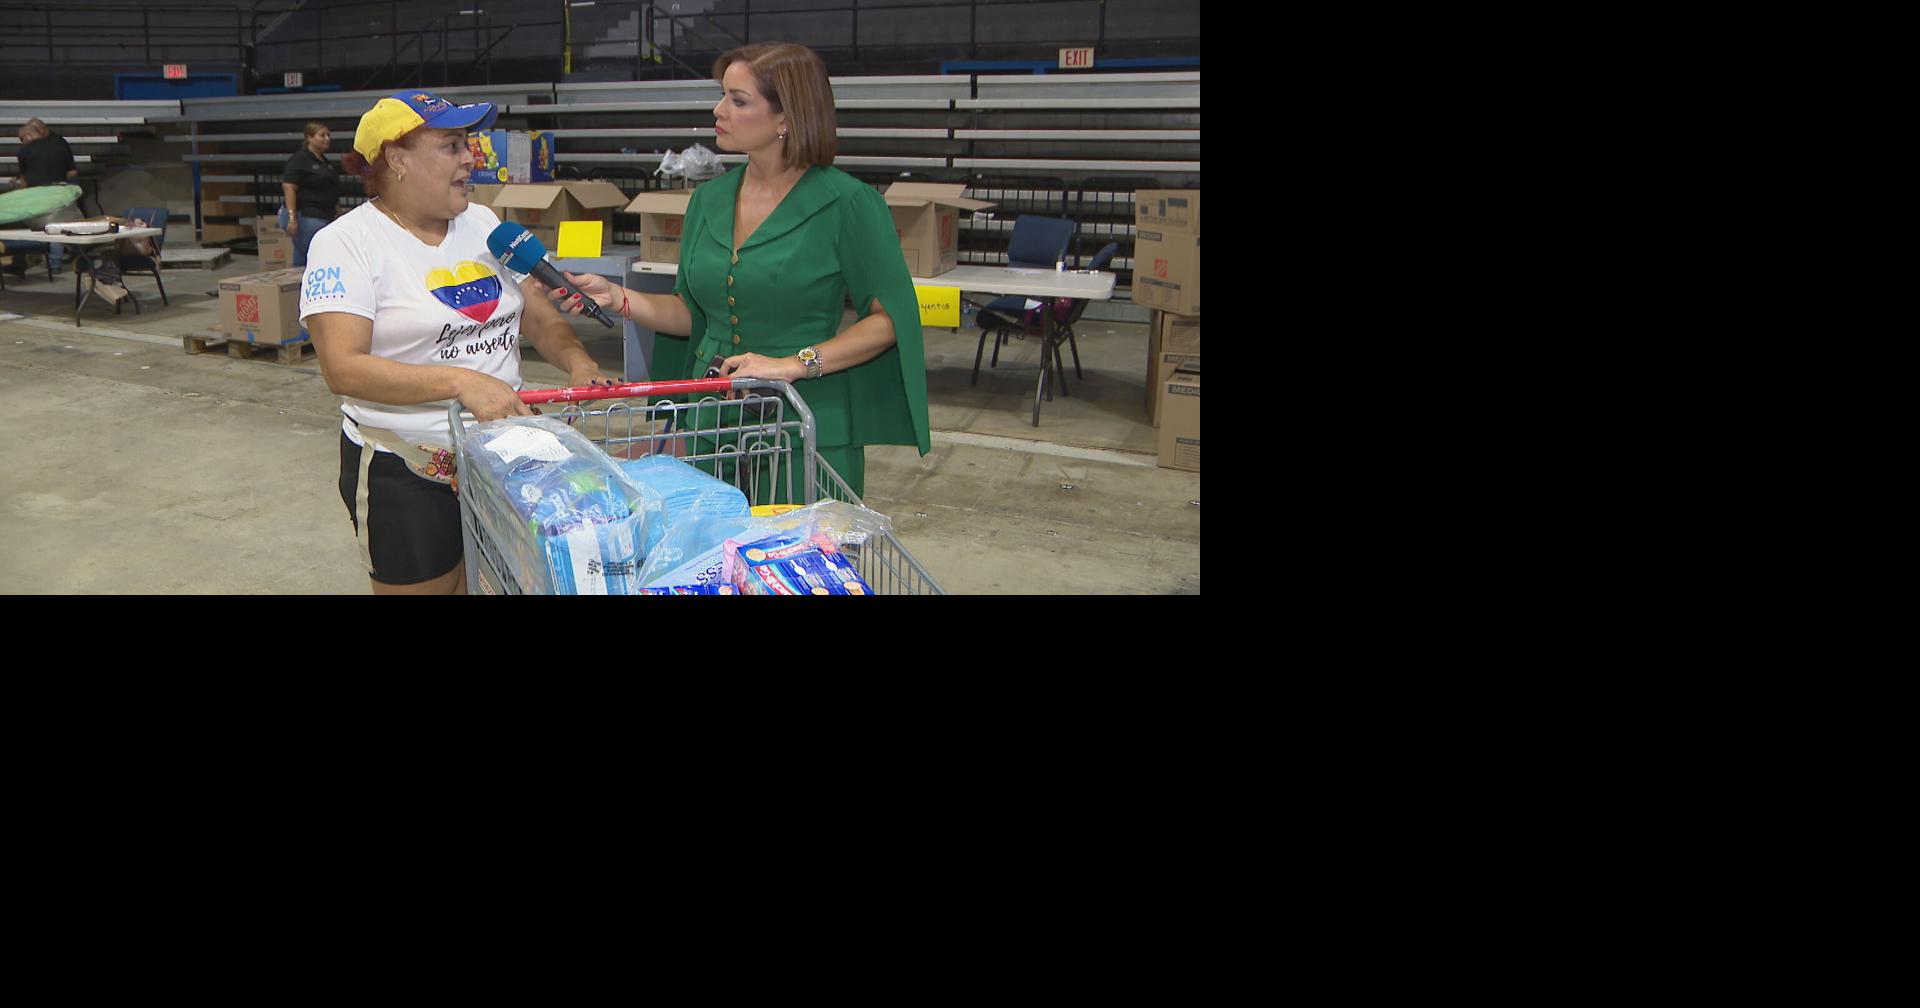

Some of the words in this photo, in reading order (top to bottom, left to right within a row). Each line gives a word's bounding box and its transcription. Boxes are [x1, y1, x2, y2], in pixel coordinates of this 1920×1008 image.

[1065, 50, 1088, 66] EXIT
[308, 266, 340, 285] CON
[306, 281, 346, 299] VZLA
[440, 345, 461, 359] no
